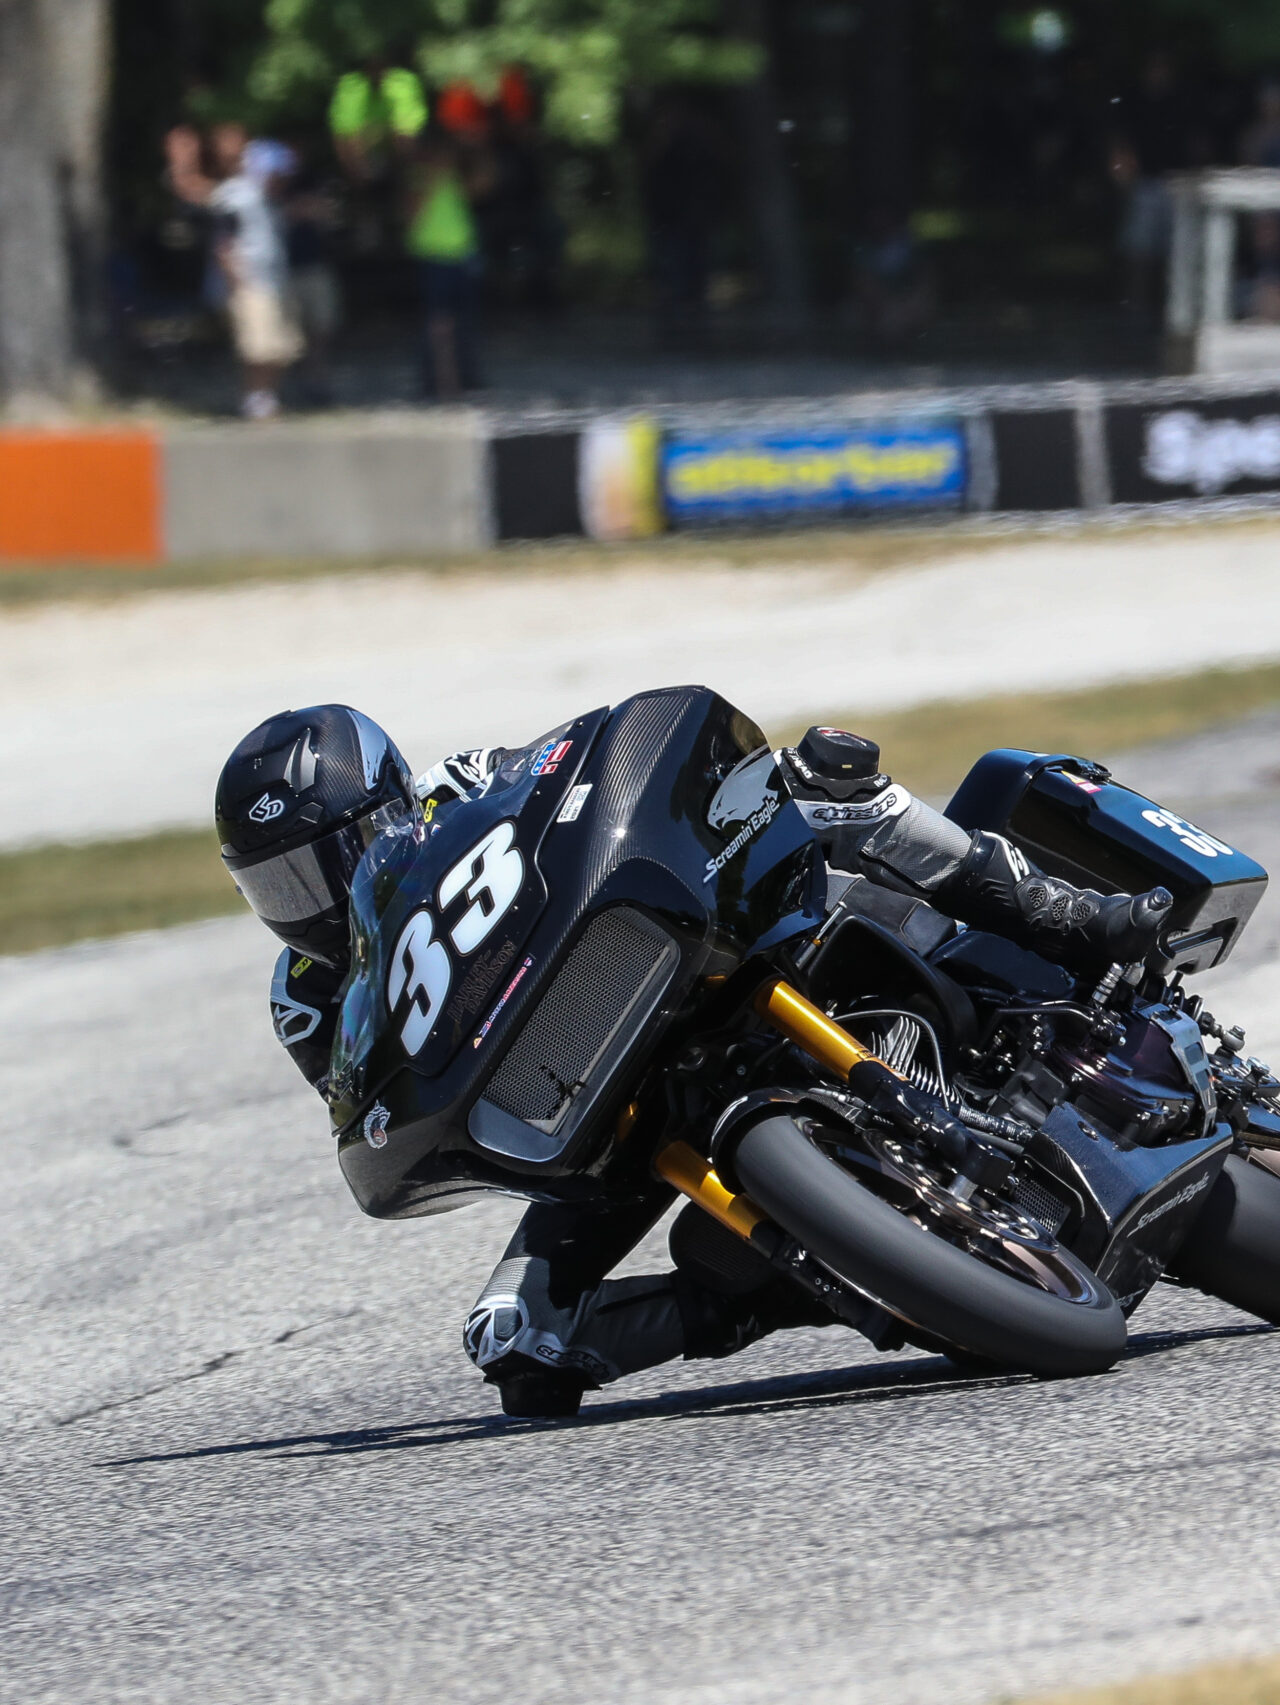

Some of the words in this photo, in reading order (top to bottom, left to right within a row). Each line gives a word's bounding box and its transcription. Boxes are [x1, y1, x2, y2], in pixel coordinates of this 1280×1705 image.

[751, 795, 780, 835] Eagle
[812, 792, 898, 822] alpinestars
[1141, 808, 1234, 858] 33
[387, 820, 525, 1057] 33
[464, 940, 517, 1014] DAVIDSON
